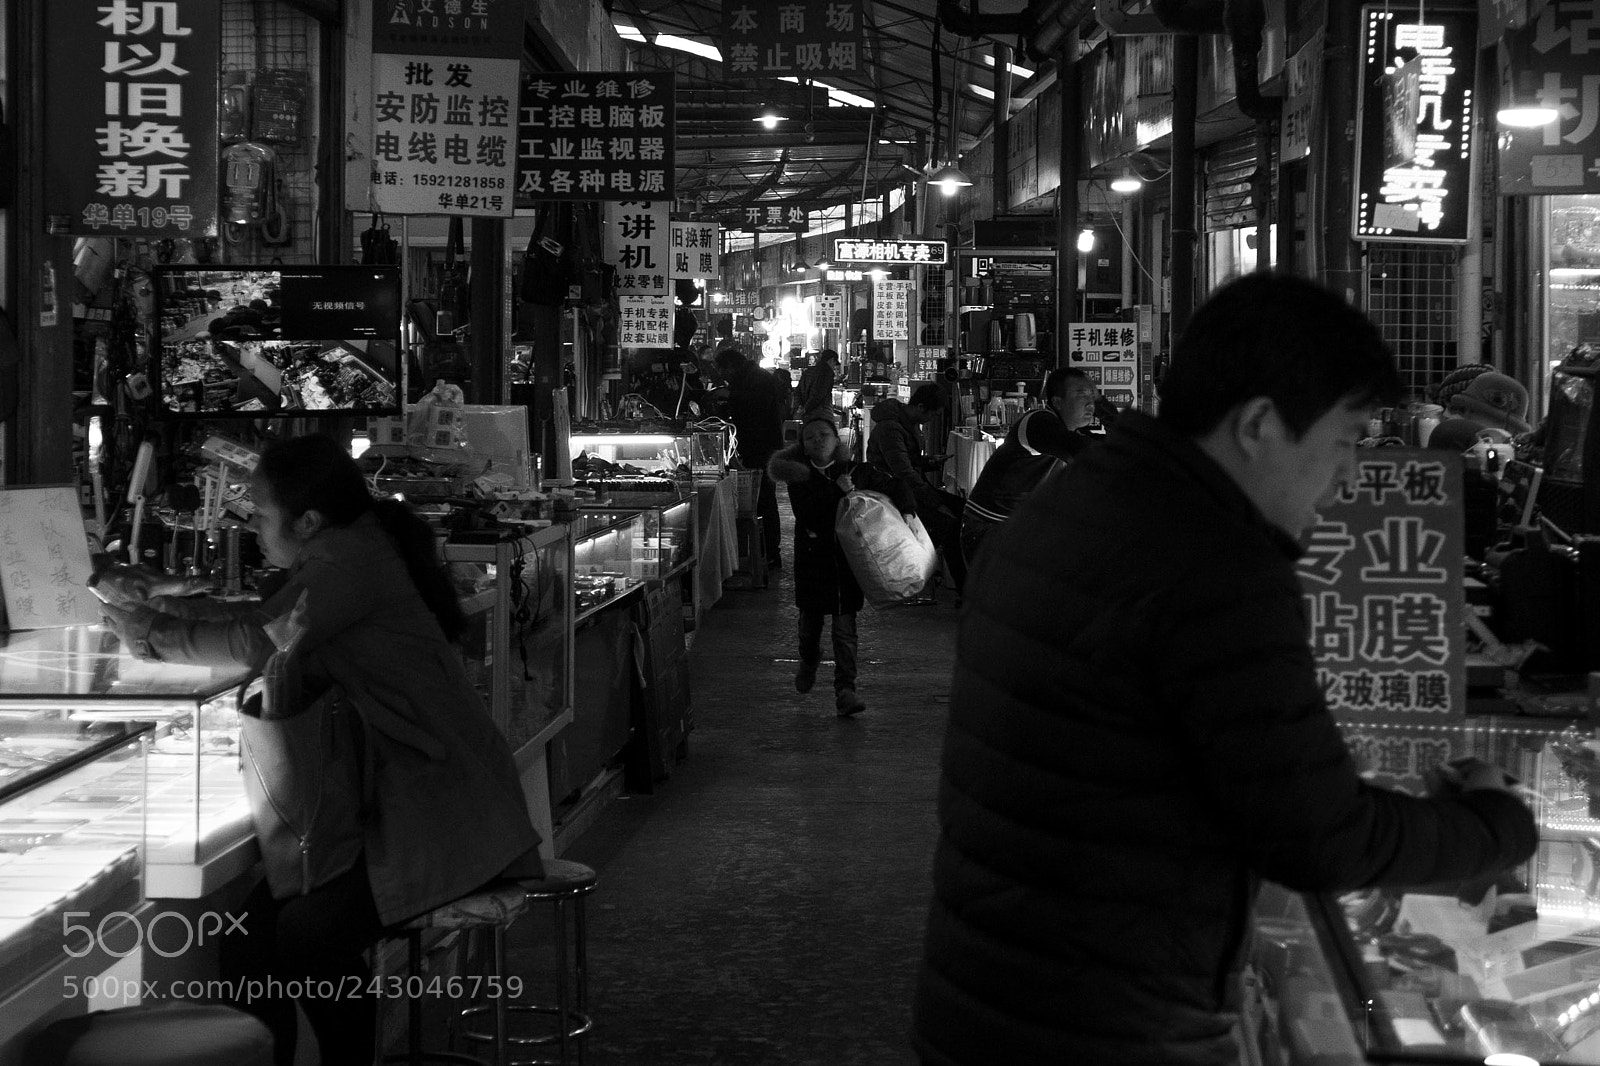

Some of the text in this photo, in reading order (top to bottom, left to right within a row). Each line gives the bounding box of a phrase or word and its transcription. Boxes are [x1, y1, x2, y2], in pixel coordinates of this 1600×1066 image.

[416, 16, 488, 30] ADSON
[730, 3, 855, 35] 本商场
[730, 42, 857, 73] 禁止吸烟
[405, 62, 473, 88] 批发
[527, 78, 656, 99] 专业维修
[96, 0, 192, 199] 机以旧换新
[375, 91, 510, 127] 安防监控
[519, 104, 666, 129] 工控电脑板
[375, 131, 507, 168] 电线电缆
[519, 137, 666, 162] 工业监视器
[413, 174, 505, 190] 15921281858
[519, 169, 666, 194] 及各种电源
[438, 193, 504, 212] 华单21号
[82, 203, 194, 231] 华单19号
[745, 206, 805, 225] 开票处
[672, 227, 713, 249] 旧换新
[676, 252, 713, 273] 贴膜
[312, 301, 366, 311] 无视频信号
[876, 291, 908, 300] 平板配
[876, 301, 908, 310] 皮套贴
[623, 307, 669, 319] 手机专卖
[876, 311, 908, 319] 高价回
[623, 319, 669, 331] 手机配件
[876, 320, 908, 329] 手机相
[623, 332, 669, 344] 皮套贴膜
[1072, 327, 1135, 347] 手机维修
[1295, 516, 1448, 585] 专业
[1302, 592, 1450, 666] 贴膜
